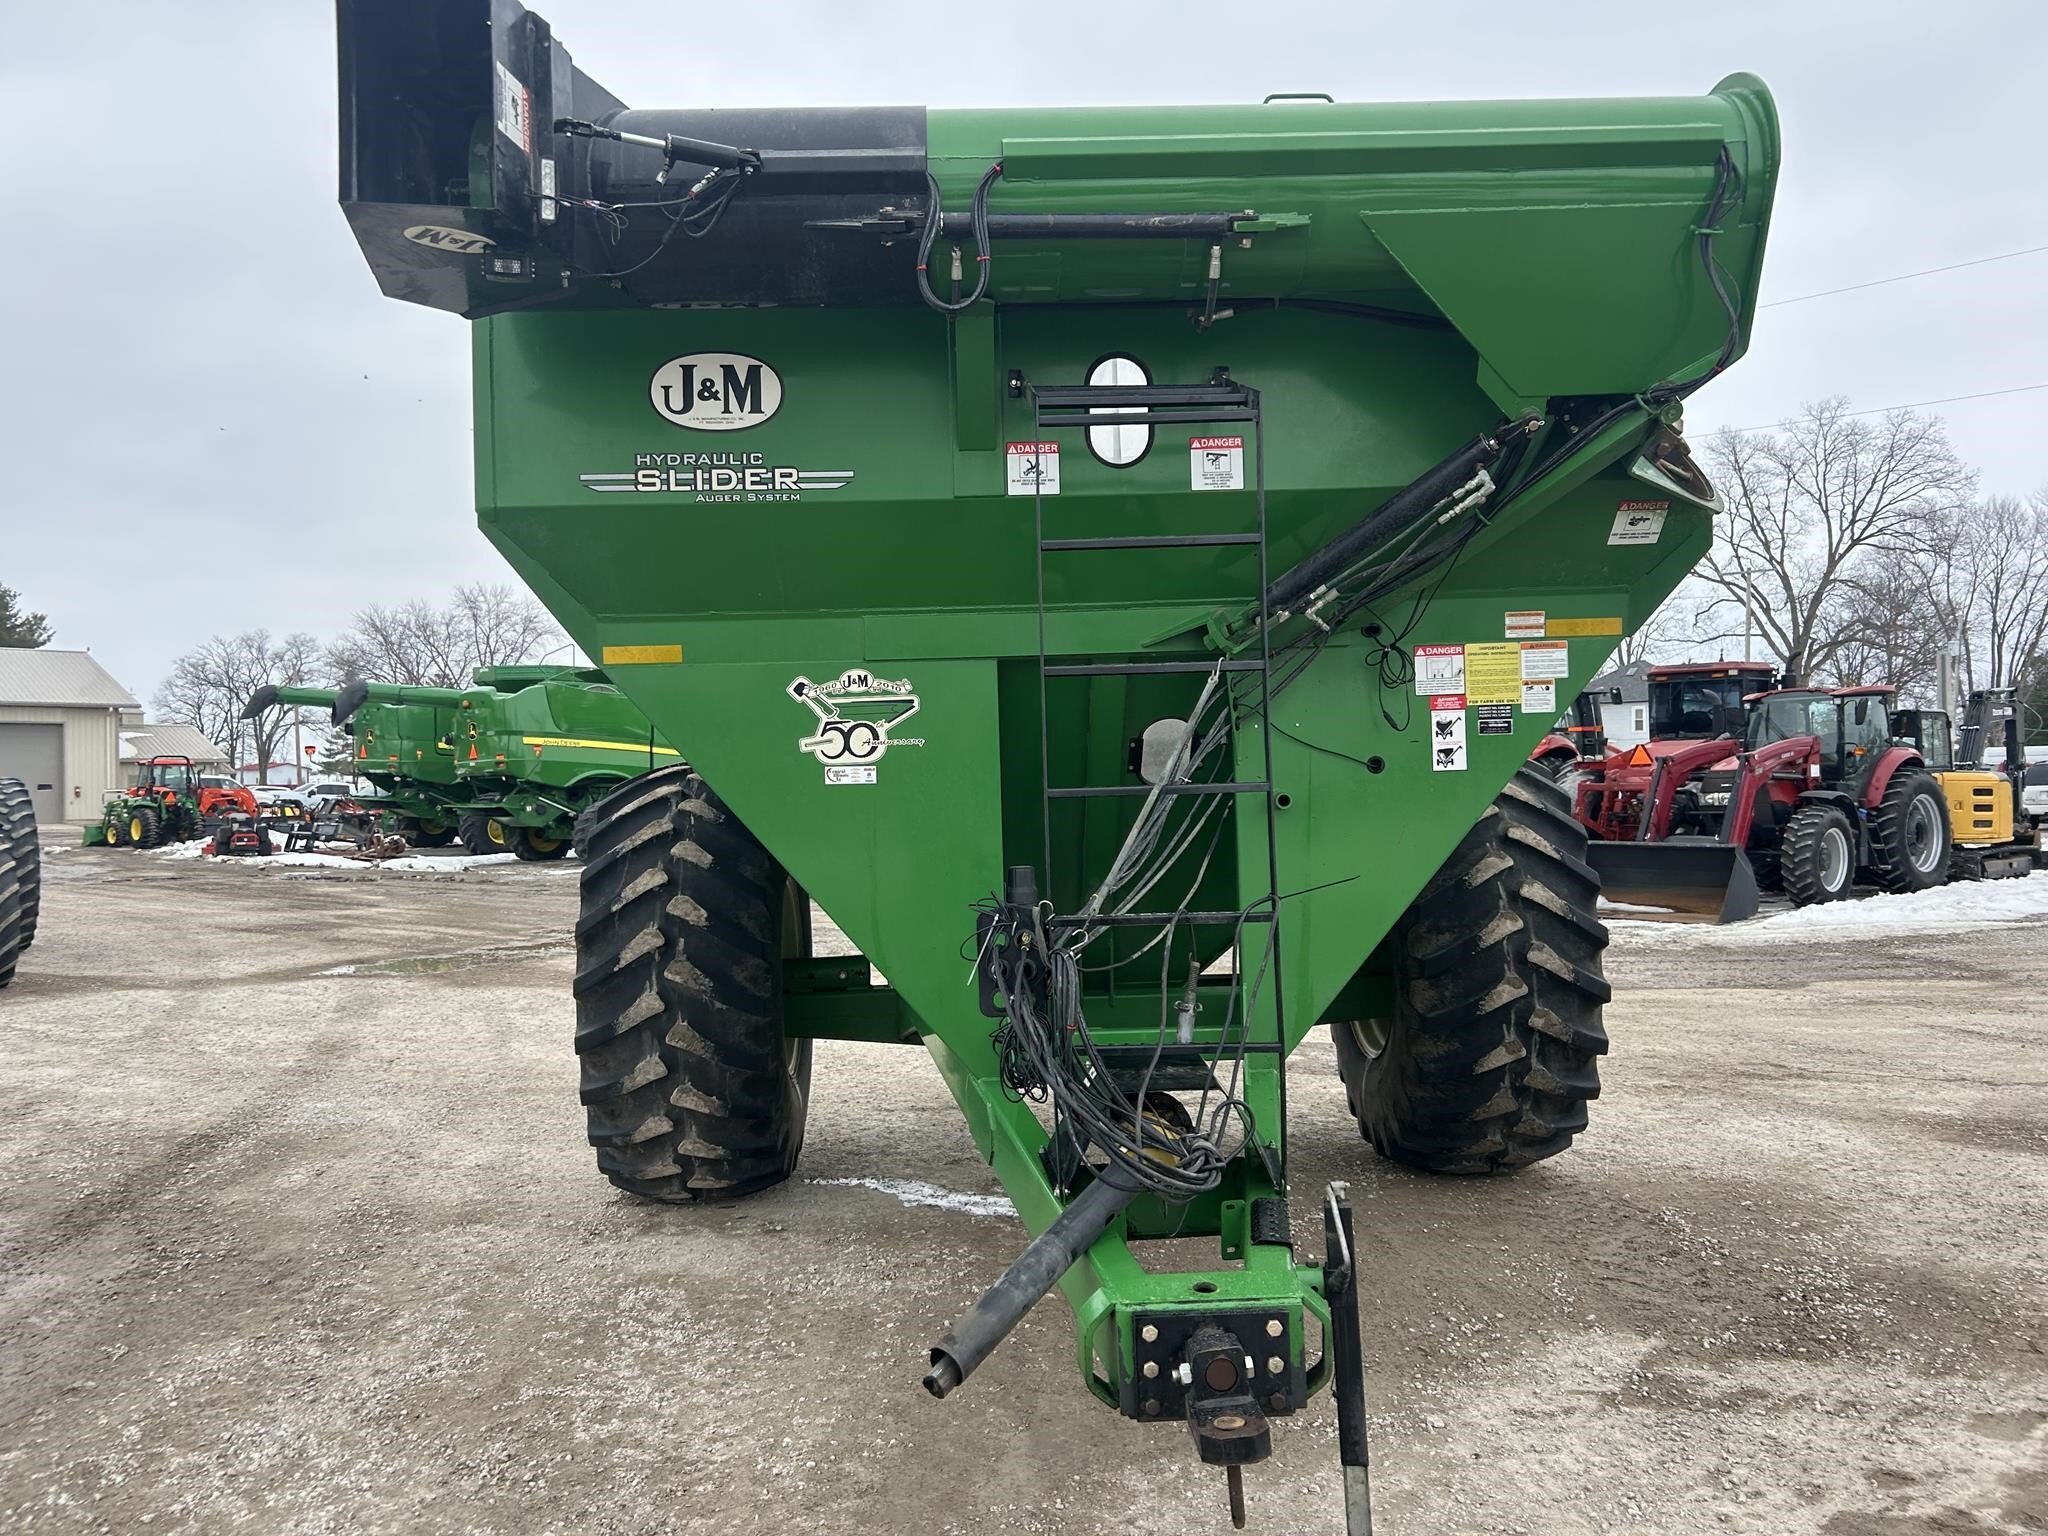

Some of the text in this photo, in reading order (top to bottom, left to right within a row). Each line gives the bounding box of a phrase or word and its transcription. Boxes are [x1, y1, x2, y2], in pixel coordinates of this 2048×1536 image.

[522, 100, 530, 152] DANGER
[661, 364, 766, 414] J&M
[1201, 438, 1241, 447] DANGER
[1017, 444, 1058, 453] DANGER
[636, 453, 763, 466] HYDRAULIC
[637, 468, 800, 491] SLIDER
[1629, 502, 1668, 510] DANGER
[1425, 646, 1463, 655] DANGER
[843, 674, 868, 688] J&M
[861, 737, 925, 747] Anniversary
